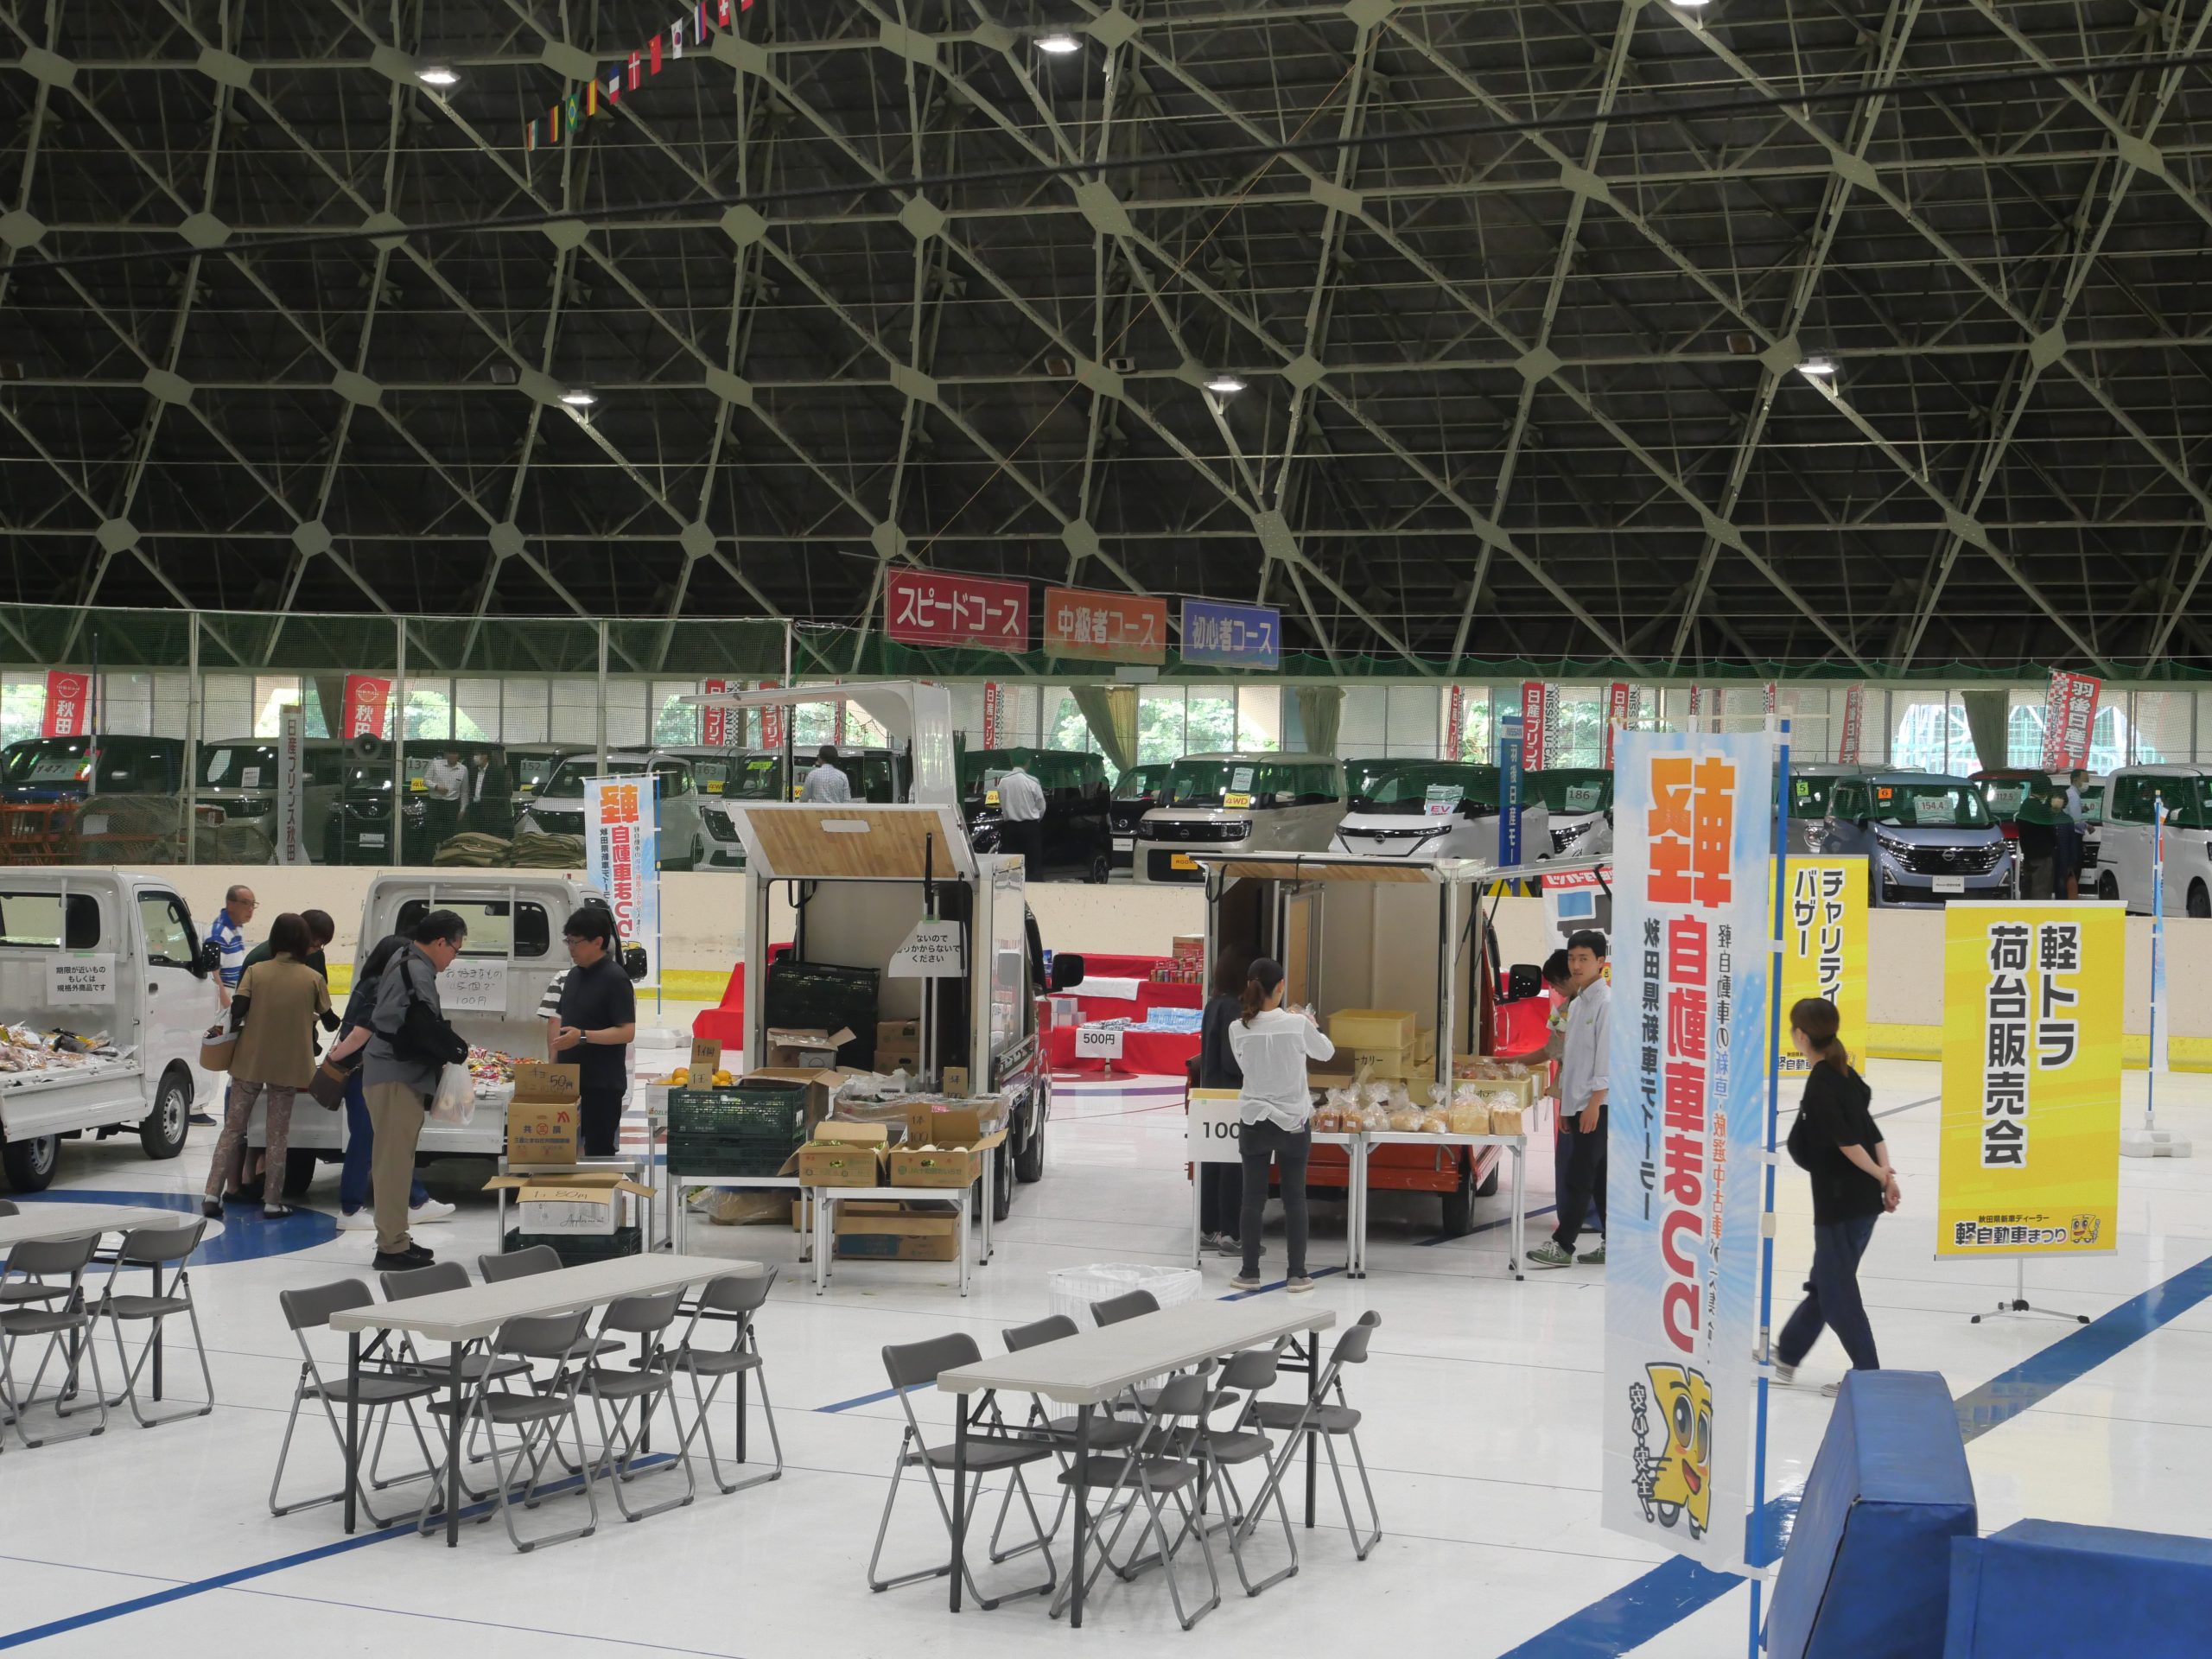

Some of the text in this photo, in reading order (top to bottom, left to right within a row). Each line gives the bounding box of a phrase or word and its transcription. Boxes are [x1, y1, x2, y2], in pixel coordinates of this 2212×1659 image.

[897, 587, 1020, 636] スピードコース
[1057, 605, 1156, 647] 中級者コース
[1192, 615, 1272, 655] 初心者コース
[55, 700, 75, 734] 秋田
[354, 704, 373, 736] 秋田
[1545, 690, 1554, 731] NISSAN
[1523, 689, 1541, 772] 日産プリンス
[286, 719, 297, 861] 日産プリンス秋田
[1224, 797, 1249, 806] 4WD
[1430, 804, 1451, 813] EV
[1921, 801, 1944, 810] 154.4
[1795, 869, 1817, 956] バザー
[896, 944, 961, 954] りかからないで
[916, 934, 948, 943] ないので
[55, 966, 106, 975] 期限が近いもの
[68, 975, 96, 983] もしくは
[456, 996, 487, 1006] 100円
[2039, 925, 2078, 1066] 軽トラ
[1083, 1033, 1116, 1046] 500円
[1984, 925, 2029, 1165] 荷台販売会
[1202, 1122, 1241, 1140] 100
[1979, 1214, 2050, 1224] 秋田県新車ディーラー
[1955, 1221, 2068, 1245] 軽自動車まつり
